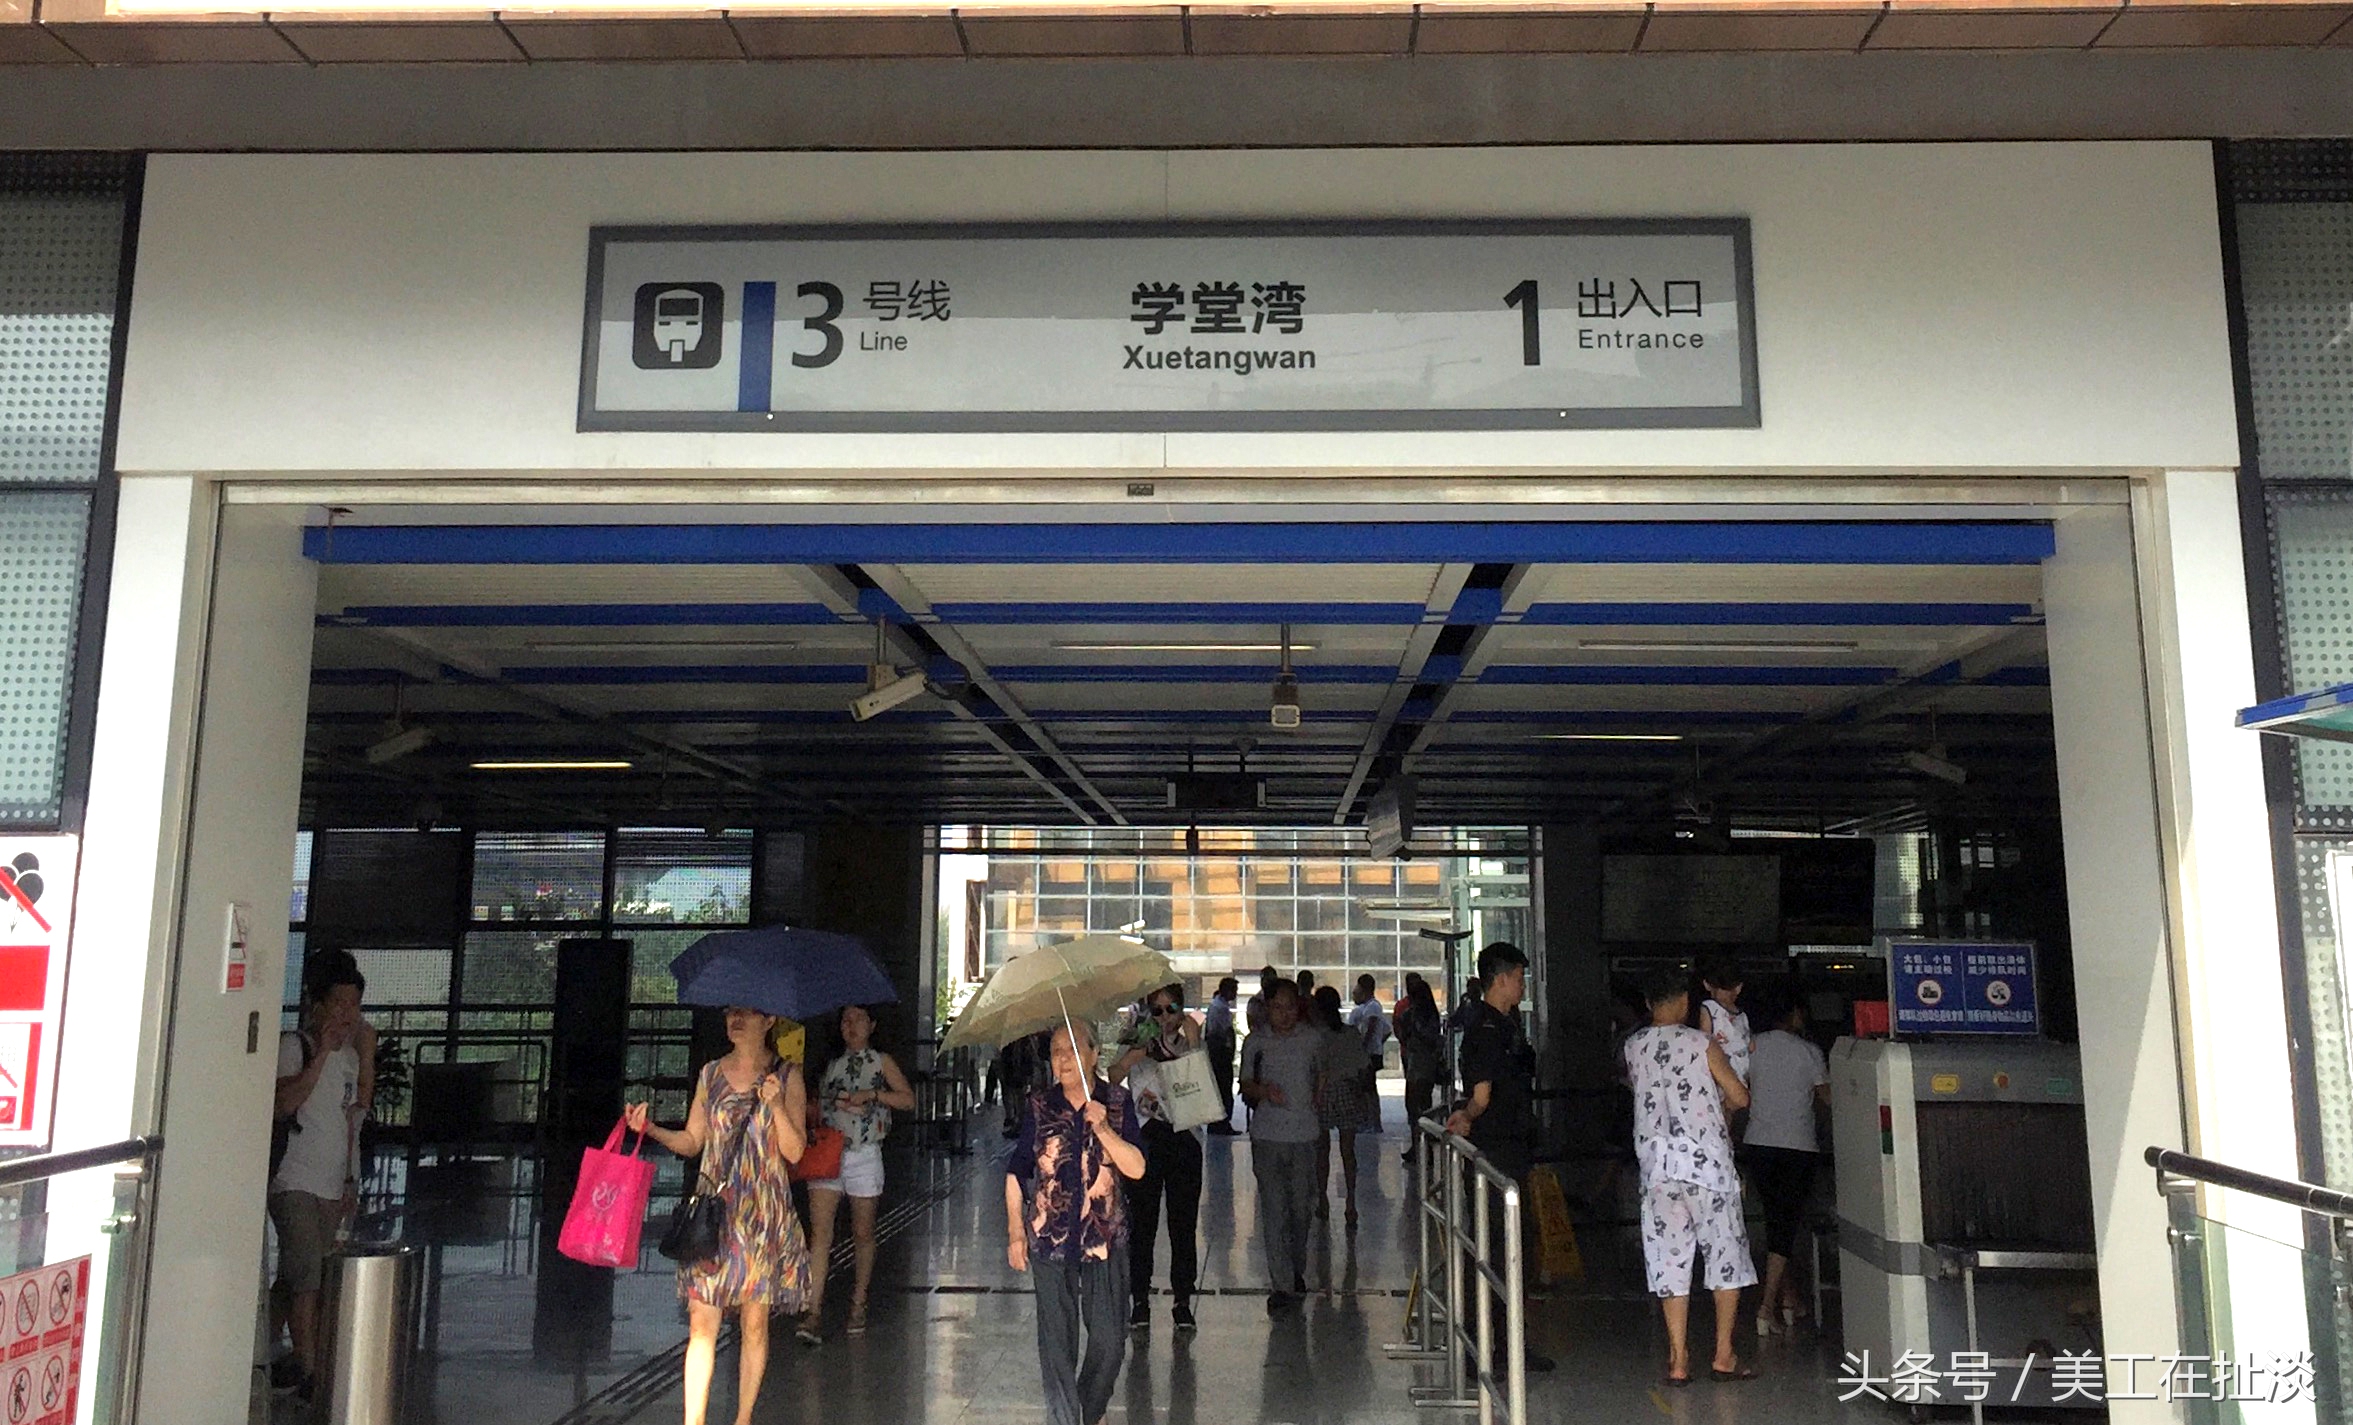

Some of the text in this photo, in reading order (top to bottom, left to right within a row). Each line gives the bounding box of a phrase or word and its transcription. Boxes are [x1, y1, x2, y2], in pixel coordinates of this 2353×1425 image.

[791, 279, 951, 368] 3 号线
[1131, 281, 1307, 335] 学堂湾
[1502, 278, 1702, 366] 1 出入口
[860, 331, 908, 351] Line
[1578, 328, 1704, 349] Entrance
[1123, 345, 1316, 376] Xuetangwan
